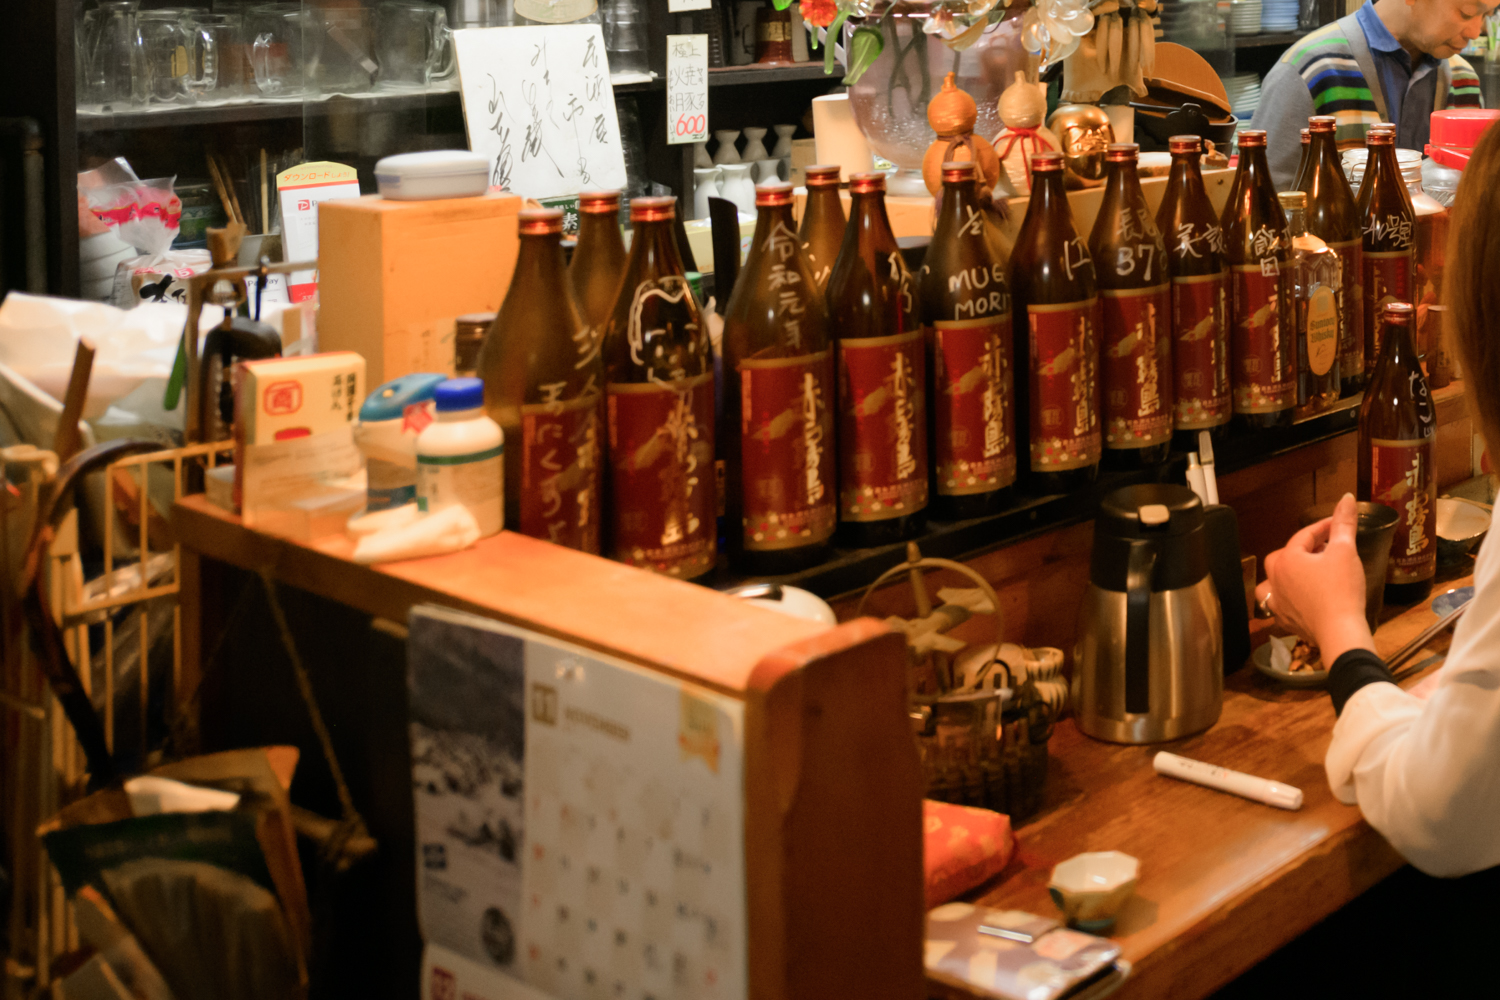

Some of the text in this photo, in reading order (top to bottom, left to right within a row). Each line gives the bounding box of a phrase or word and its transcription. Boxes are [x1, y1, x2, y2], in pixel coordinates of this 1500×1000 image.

[671, 42, 702, 59] 極上
[676, 113, 706, 137] 600
[1405, 451, 1430, 557] 赤霧島
